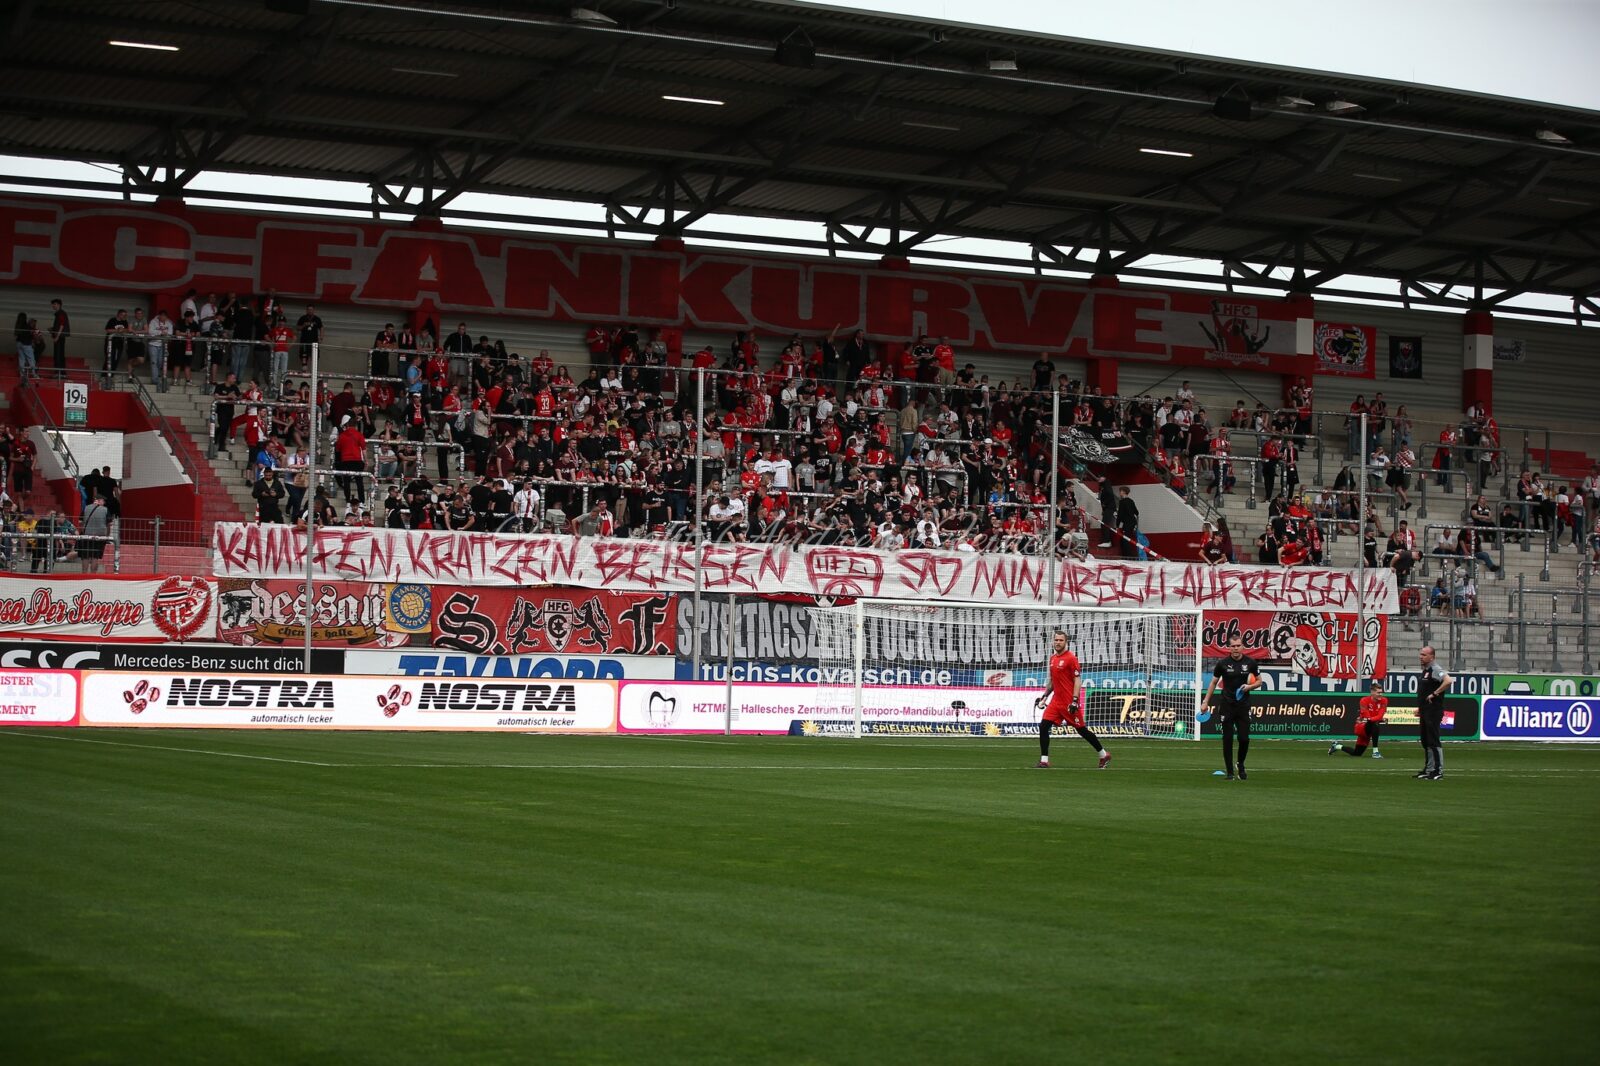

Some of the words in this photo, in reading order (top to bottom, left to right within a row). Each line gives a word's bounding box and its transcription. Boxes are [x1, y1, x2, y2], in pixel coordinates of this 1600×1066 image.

[1223, 304, 1250, 316] HFC
[65, 389, 87, 404] 19b
[541, 397, 550, 410] 33
[877, 452, 883, 465] 2
[591, 541, 791, 591] BEISSEN
[1054, 558, 1166, 607] ARSCH
[26, 587, 68, 625] Per
[68, 589, 144, 636] Sempre
[548, 601, 570, 612] HFC
[114, 653, 226, 670] Mercedes-Benz
[229, 656, 270, 671] sucht
[273, 656, 304, 671] dich
[701, 662, 952, 685] fuchs-kovasch.de
[166, 678, 335, 708] NOSTRA
[417, 683, 577, 712] NOSTRA
[0, 705, 37, 715] MENT
[741, 704, 795, 714] Hallesches
[797, 705, 837, 715] Zentrum
[841, 704, 854, 715] für
[962, 707, 1013, 718] Regulation
[1266, 704, 1275, 716] in
[1278, 704, 1306, 717] Halle
[1308, 704, 1346, 718] (Saale)
[1496, 706, 1563, 728] Allianz
[250, 713, 304, 723] automatisch
[306, 713, 333, 724] lecker
[497, 717, 548, 727] automatisch
[550, 717, 575, 728] lecker
[823, 724, 869, 733] MERKR
[872, 724, 933, 733] SPIELBANK
[936, 725, 971, 734] HALLE
[1110, 725, 1144, 735] HALLE
